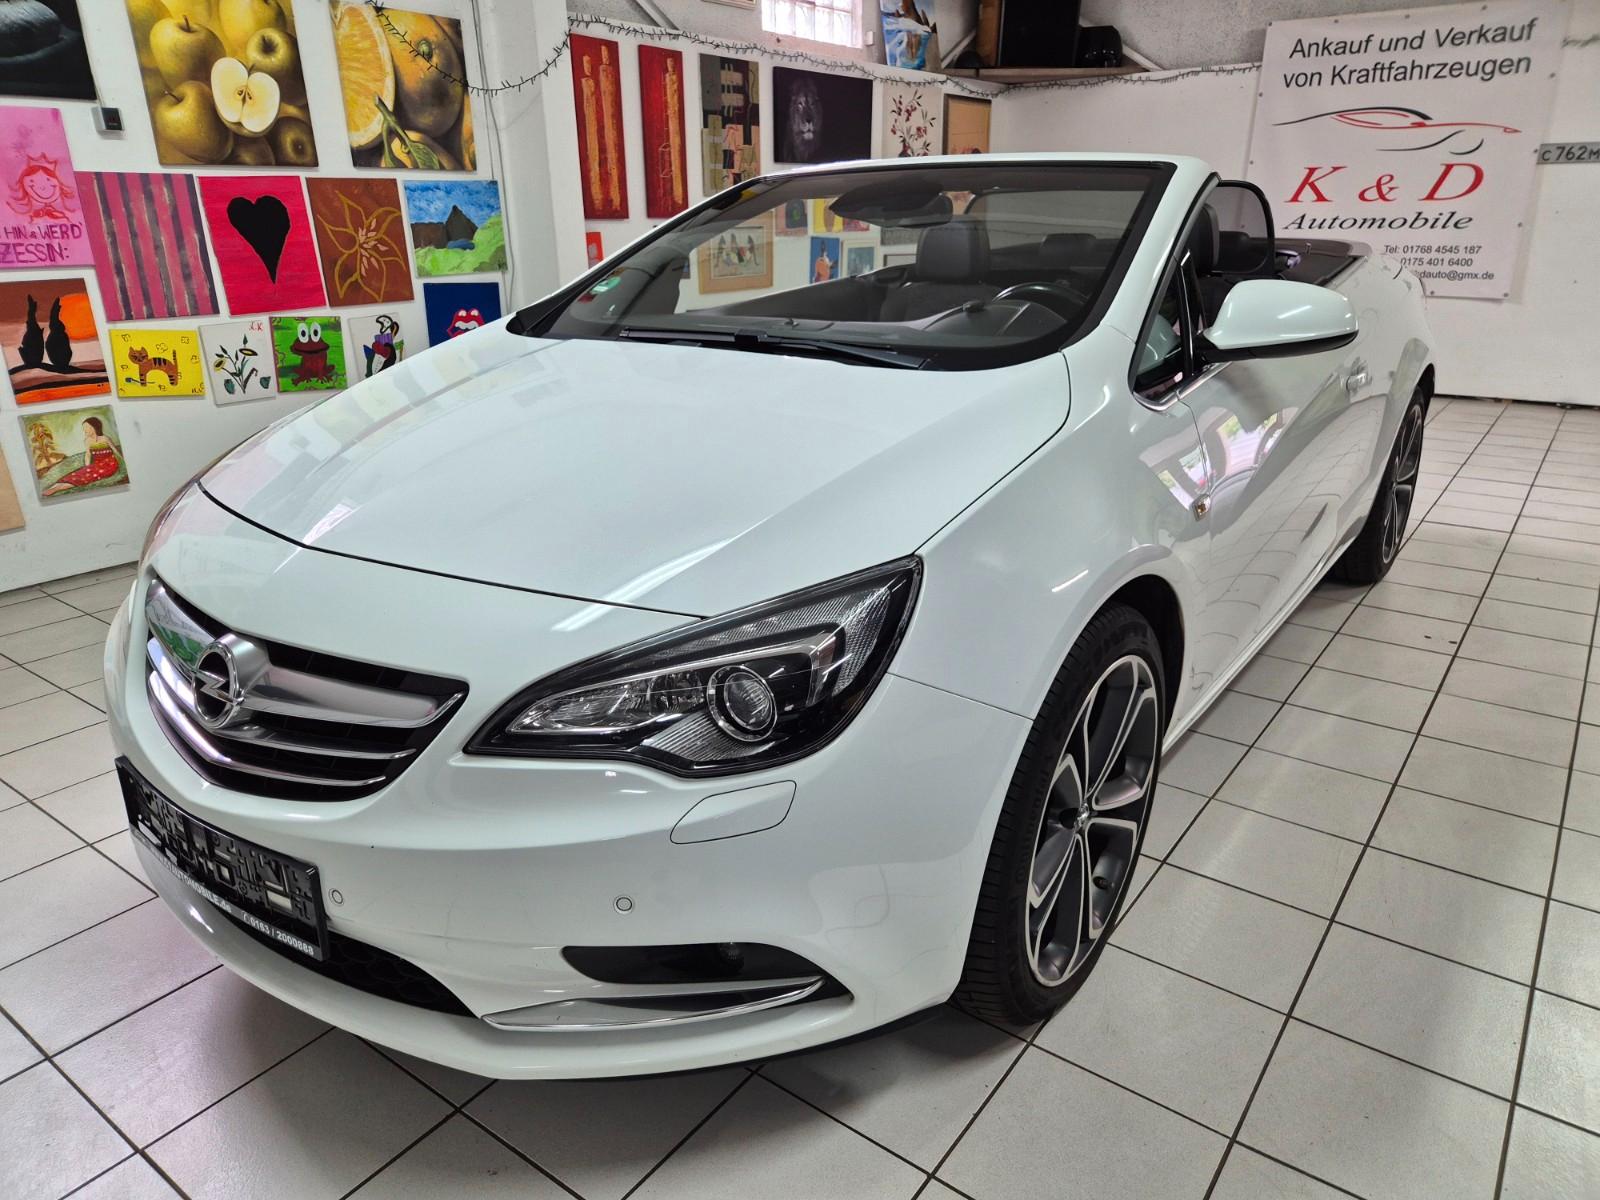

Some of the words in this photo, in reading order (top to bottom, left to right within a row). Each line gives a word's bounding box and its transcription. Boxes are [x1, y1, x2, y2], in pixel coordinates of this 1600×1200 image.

[1289, 34, 1375, 59] Ankauf
[1379, 30, 1425, 52] und
[1435, 18, 1538, 48] Verkauf
[1283, 70, 1322, 88] von
[1331, 56, 1532, 87] Kraftfahrzeugen
[1285, 166, 1347, 203] K
[1358, 174, 1400, 202] &
[1418, 163, 1484, 201] D
[1282, 211, 1474, 230] Automobile
[1384, 245, 1400, 254] Tel:
[1402, 245, 1432, 254] 01768
[1435, 245, 1460, 254] 4545
[1464, 245, 1482, 254] 187
[1400, 257, 1424, 266] 0175
[1426, 257, 1444, 266] 401
[1448, 257, 1473, 267] 6400
